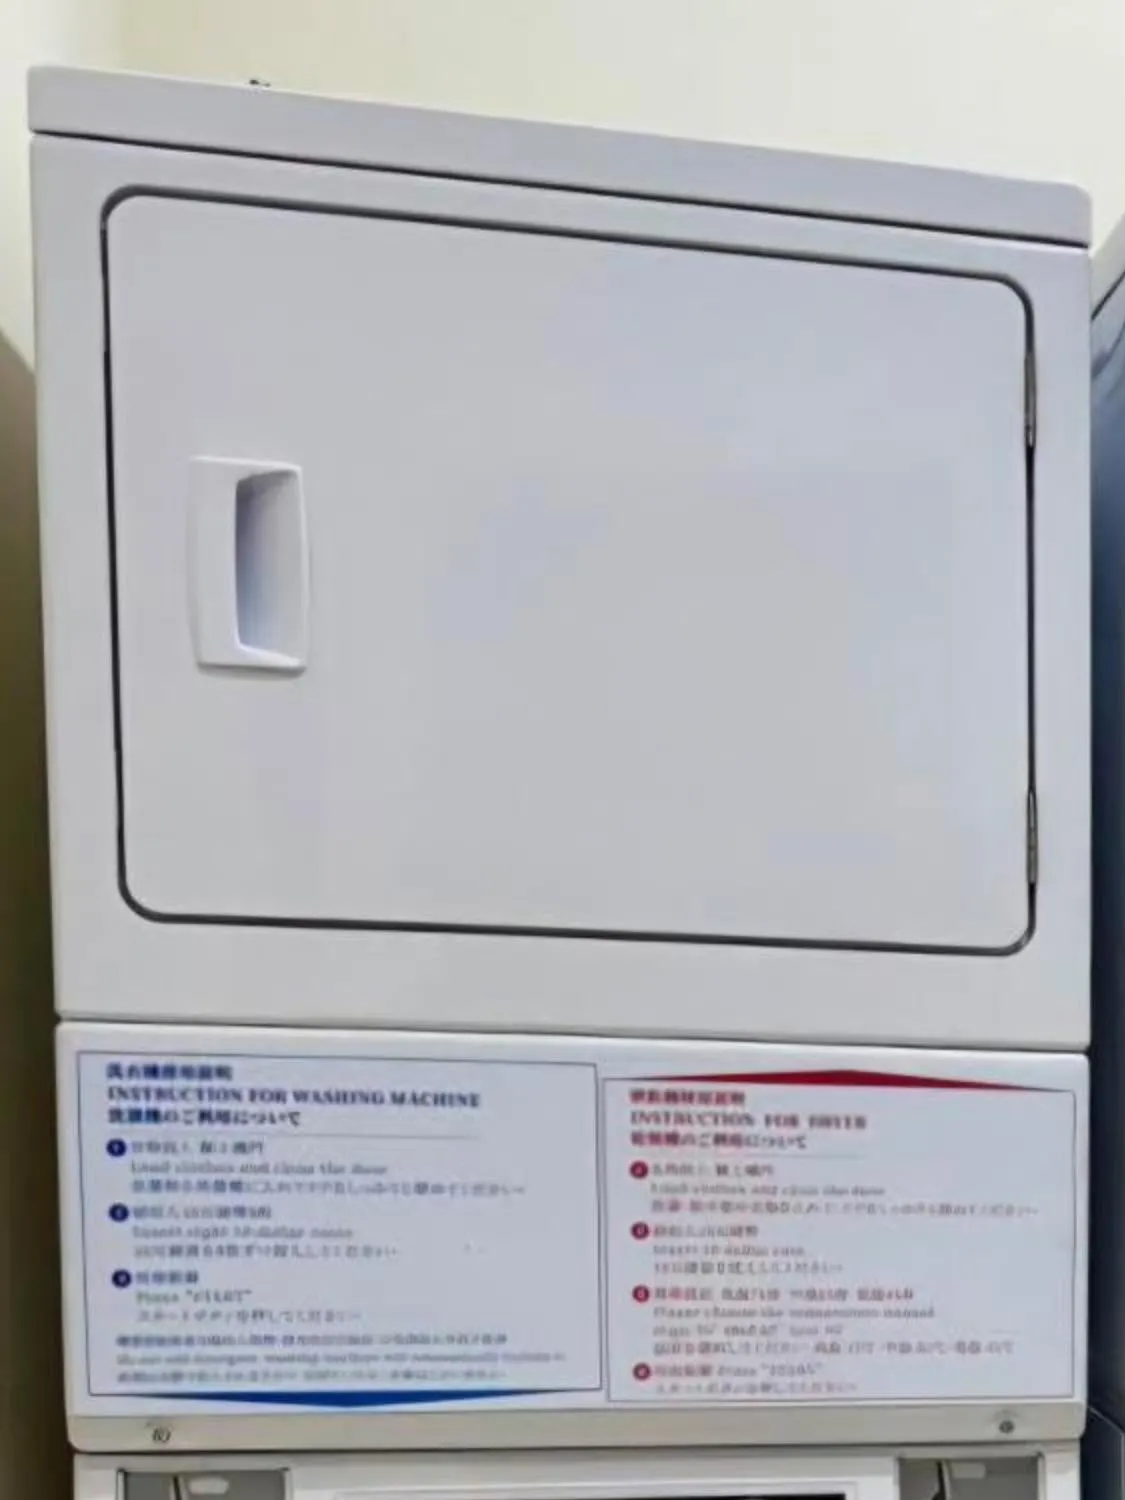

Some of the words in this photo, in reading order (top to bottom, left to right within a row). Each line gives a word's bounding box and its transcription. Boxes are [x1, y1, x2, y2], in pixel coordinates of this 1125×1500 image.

[107, 1085, 244, 1103] INSTRUCTION
[247, 1087, 288, 1105] FOR
[291, 1089, 386, 1106] WASHING
[389, 1091, 480, 1108] MACHINE
